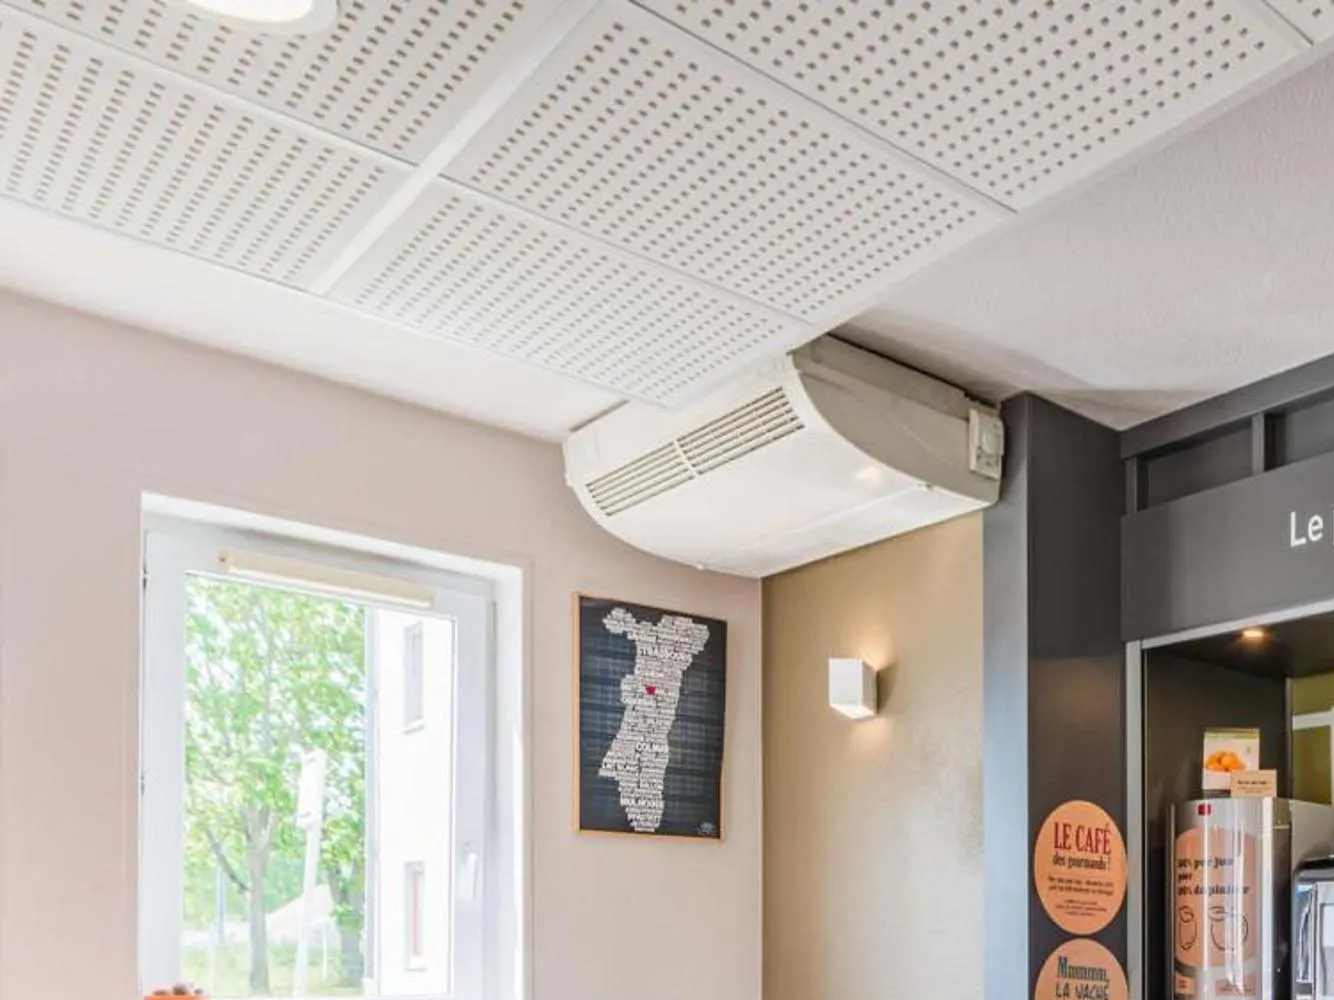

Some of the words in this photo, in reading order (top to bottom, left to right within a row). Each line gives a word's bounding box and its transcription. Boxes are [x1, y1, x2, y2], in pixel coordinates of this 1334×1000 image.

[1290, 511, 1323, 547] Le
[1054, 822, 1072, 850] LE
[1075, 823, 1112, 855] CAFÉ
[1055, 982, 1070, 998] LA
